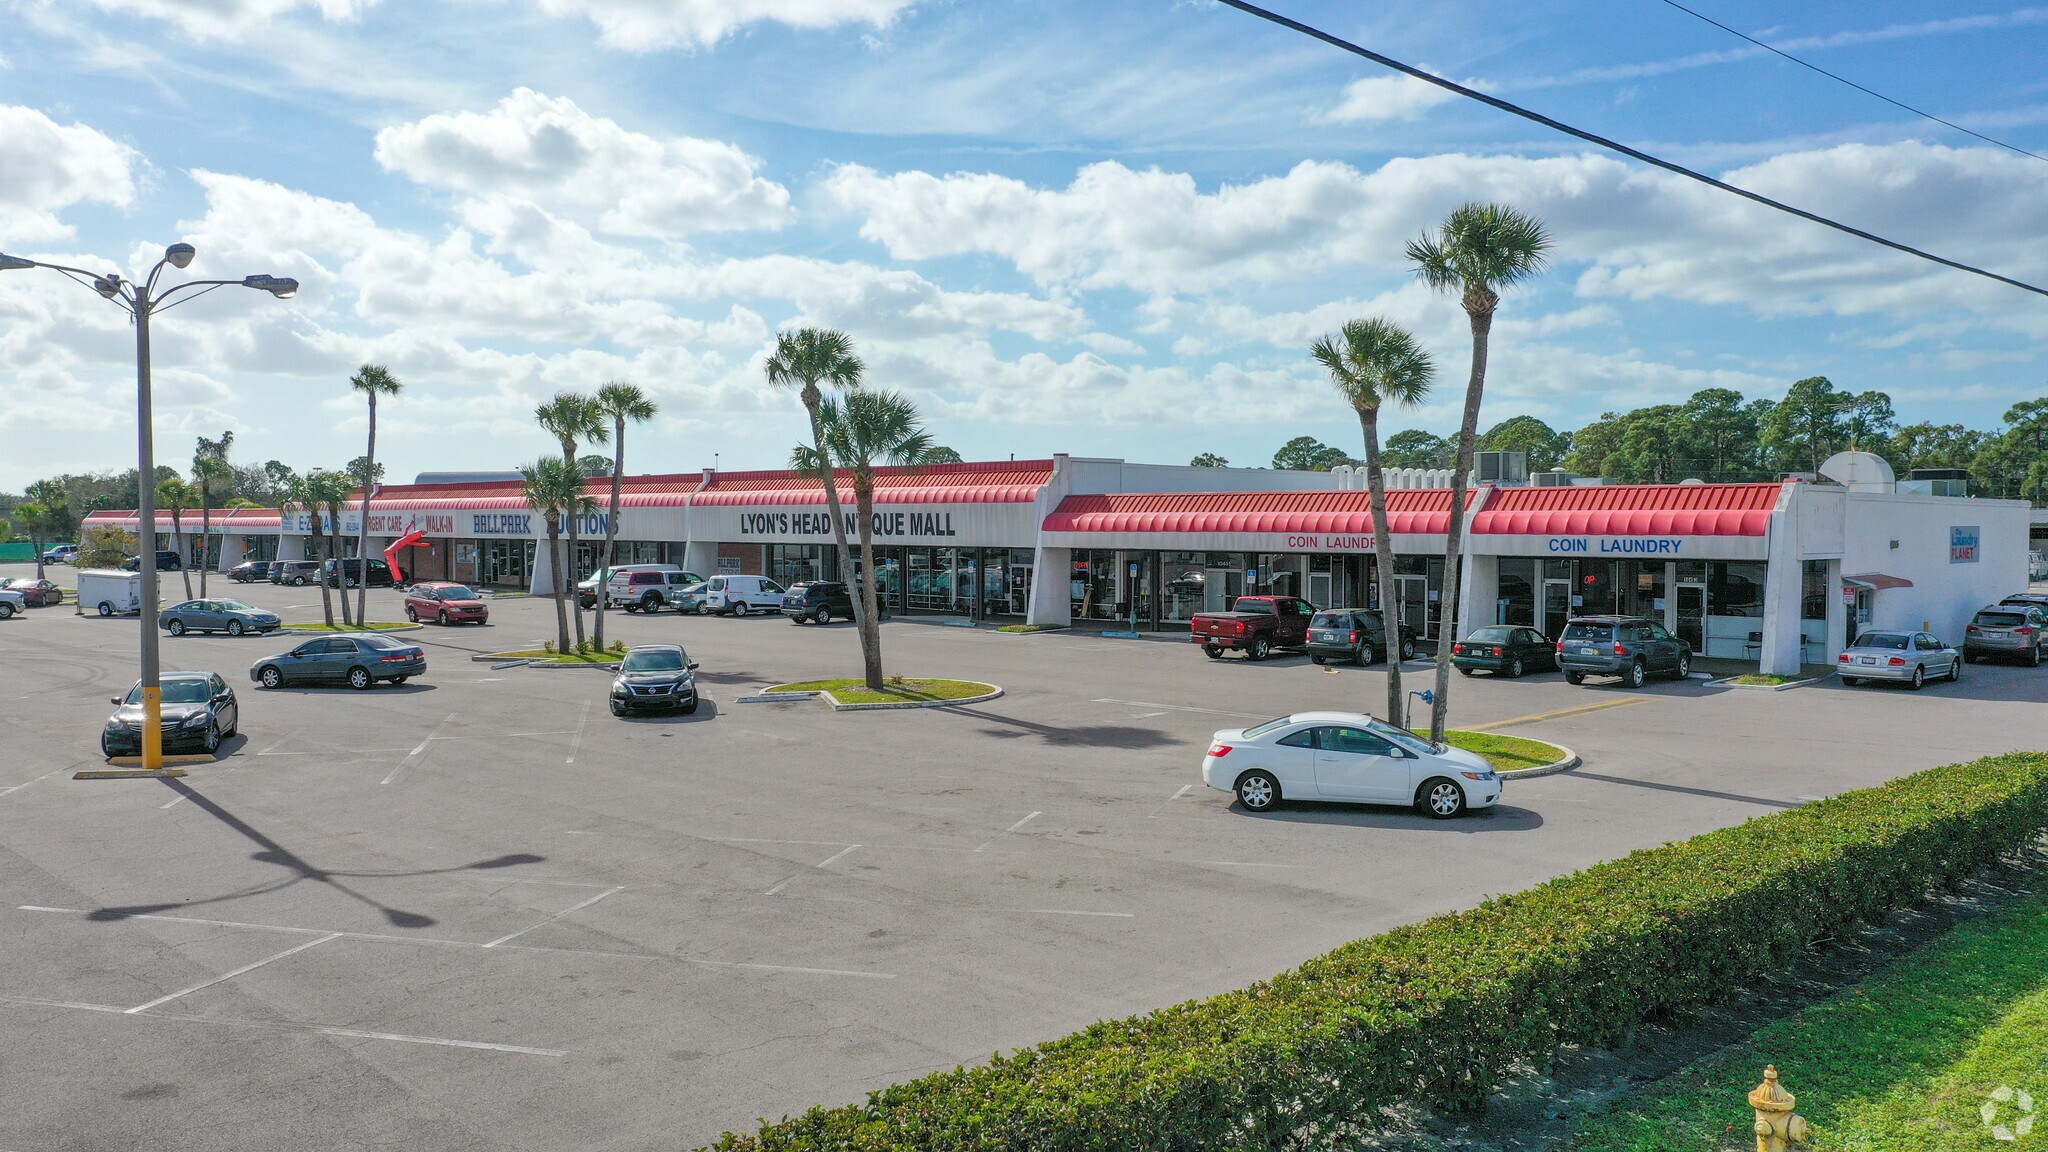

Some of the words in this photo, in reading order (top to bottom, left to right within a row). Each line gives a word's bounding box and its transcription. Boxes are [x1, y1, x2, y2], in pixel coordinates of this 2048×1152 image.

[367, 516, 386, 532] RGENT
[387, 516, 403, 532] CARE
[426, 515, 453, 533] WALK-IN
[473, 514, 531, 534] BALLPARK
[741, 513, 788, 534] LYON'S
[792, 513, 831, 535] HEAD
[910, 513, 955, 536] MALL
[1288, 536, 1318, 548] COIN
[1326, 536, 1376, 549] LAUNDR
[1549, 538, 1587, 552] COIN
[1601, 539, 1682, 553] LAUNDRY
[1951, 547, 1974, 560] PLANET
